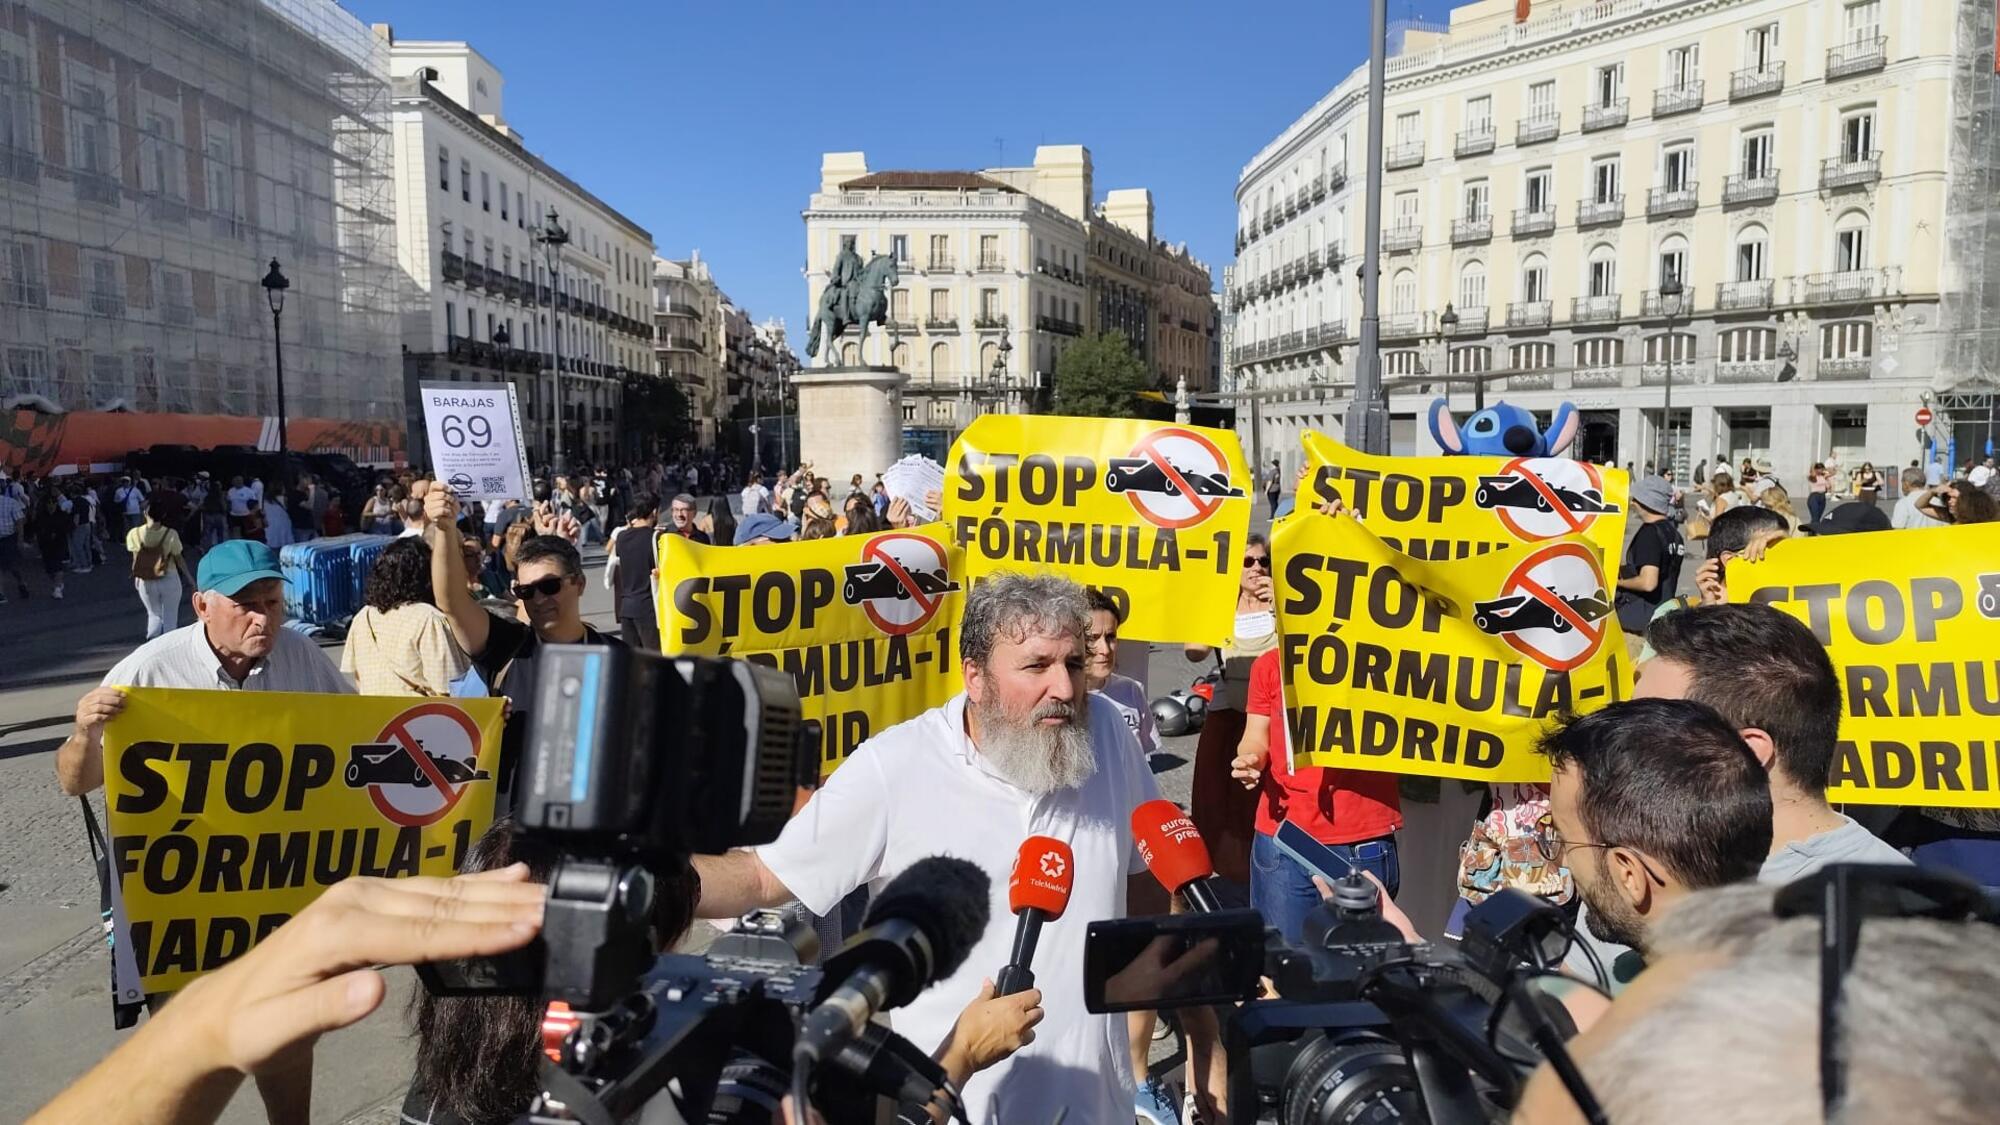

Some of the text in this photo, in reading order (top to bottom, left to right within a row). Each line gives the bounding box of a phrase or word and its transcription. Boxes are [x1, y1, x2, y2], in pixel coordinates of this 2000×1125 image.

[1221, 323, 1233, 394] MODERNO
[433, 397, 495, 409] BARAJAS
[441, 414, 493, 449] 69
[957, 452, 1097, 508] STOP
[1311, 465, 1467, 524] STOP
[957, 506, 1232, 575] FÓRMULA-1
[673, 568, 835, 645] STOP
[1284, 552, 1462, 634] STOP
[716, 627, 950, 698] MULA-1
[1283, 621, 1620, 720] FÓRMULA-1
[1289, 705, 1505, 770] MADRID
[1828, 739, 2000, 792] ADRI
[116, 741, 336, 815] STOP
[113, 819, 473, 895] FÓRMULA-1
[1030, 878, 1067, 895] TeleMadrid
